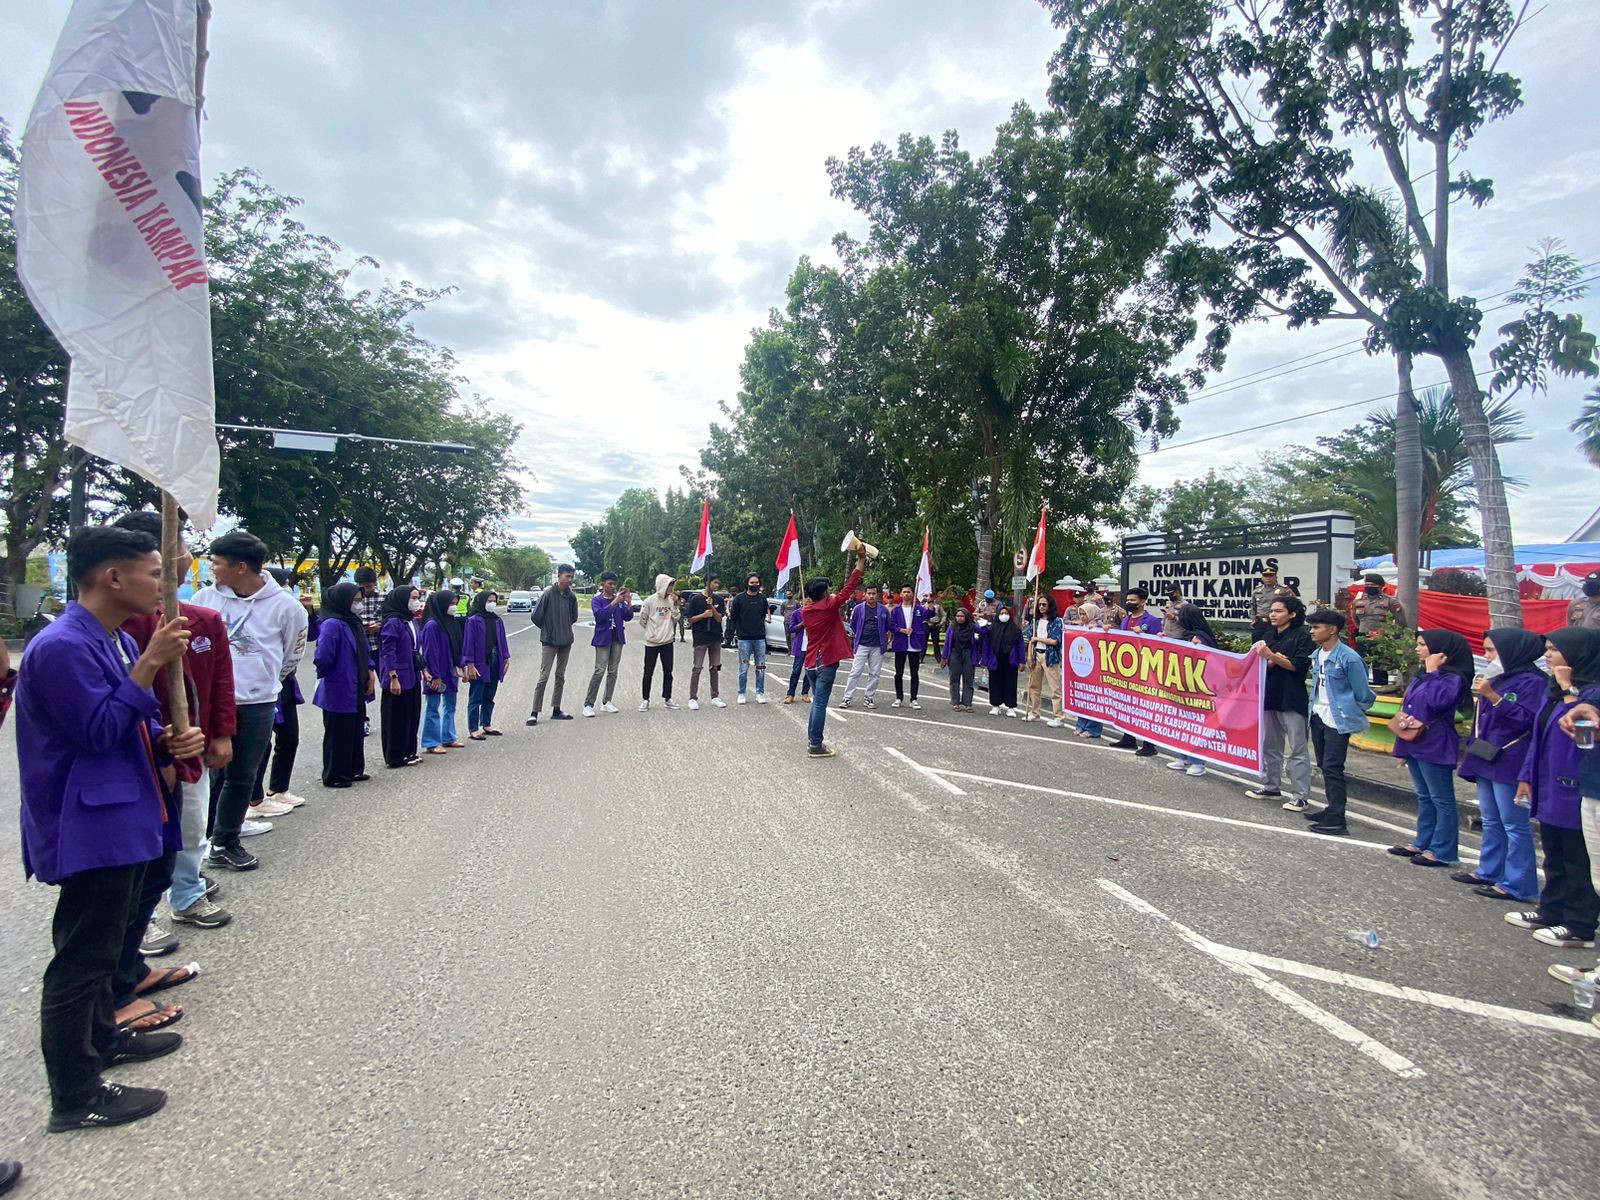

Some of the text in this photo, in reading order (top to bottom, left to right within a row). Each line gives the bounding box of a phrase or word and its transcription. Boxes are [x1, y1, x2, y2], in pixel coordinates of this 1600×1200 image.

[64, 101, 208, 290] INDONESIA KAMPAR
[1153, 558, 1279, 577] RUMAH DINAS
[1203, 576, 1300, 597] KAMPR
[1218, 609, 1251, 619] KAMPA
[1098, 639, 1216, 696] KOMAK
[1069, 680, 1074, 688] 1.
[1074, 681, 1103, 695] TUNTASKAN
[1132, 696, 1138, 706] DI
[1139, 698, 1177, 716] KABUPATEN
[1178, 707, 1205, 723] KAMPAR
[1069, 689, 1074, 697] 2.
[1074, 690, 1096, 702] KURANGI
[1155, 713, 1162, 723] DI
[1164, 716, 1202, 734] KABUPATEN
[1202, 727, 1227, 741] KAMPAR
[1185, 697, 1211, 710] KAMPAR
[1074, 699, 1104, 713] TUNTASKAN
[1131, 717, 1150, 730] PUTUS
[1151, 723, 1180, 740] SEKOLAH
[1181, 733, 1188, 743] DI
[1190, 735, 1226, 753] KABUPATEN
[1227, 744, 1257, 761] KAMPAR
